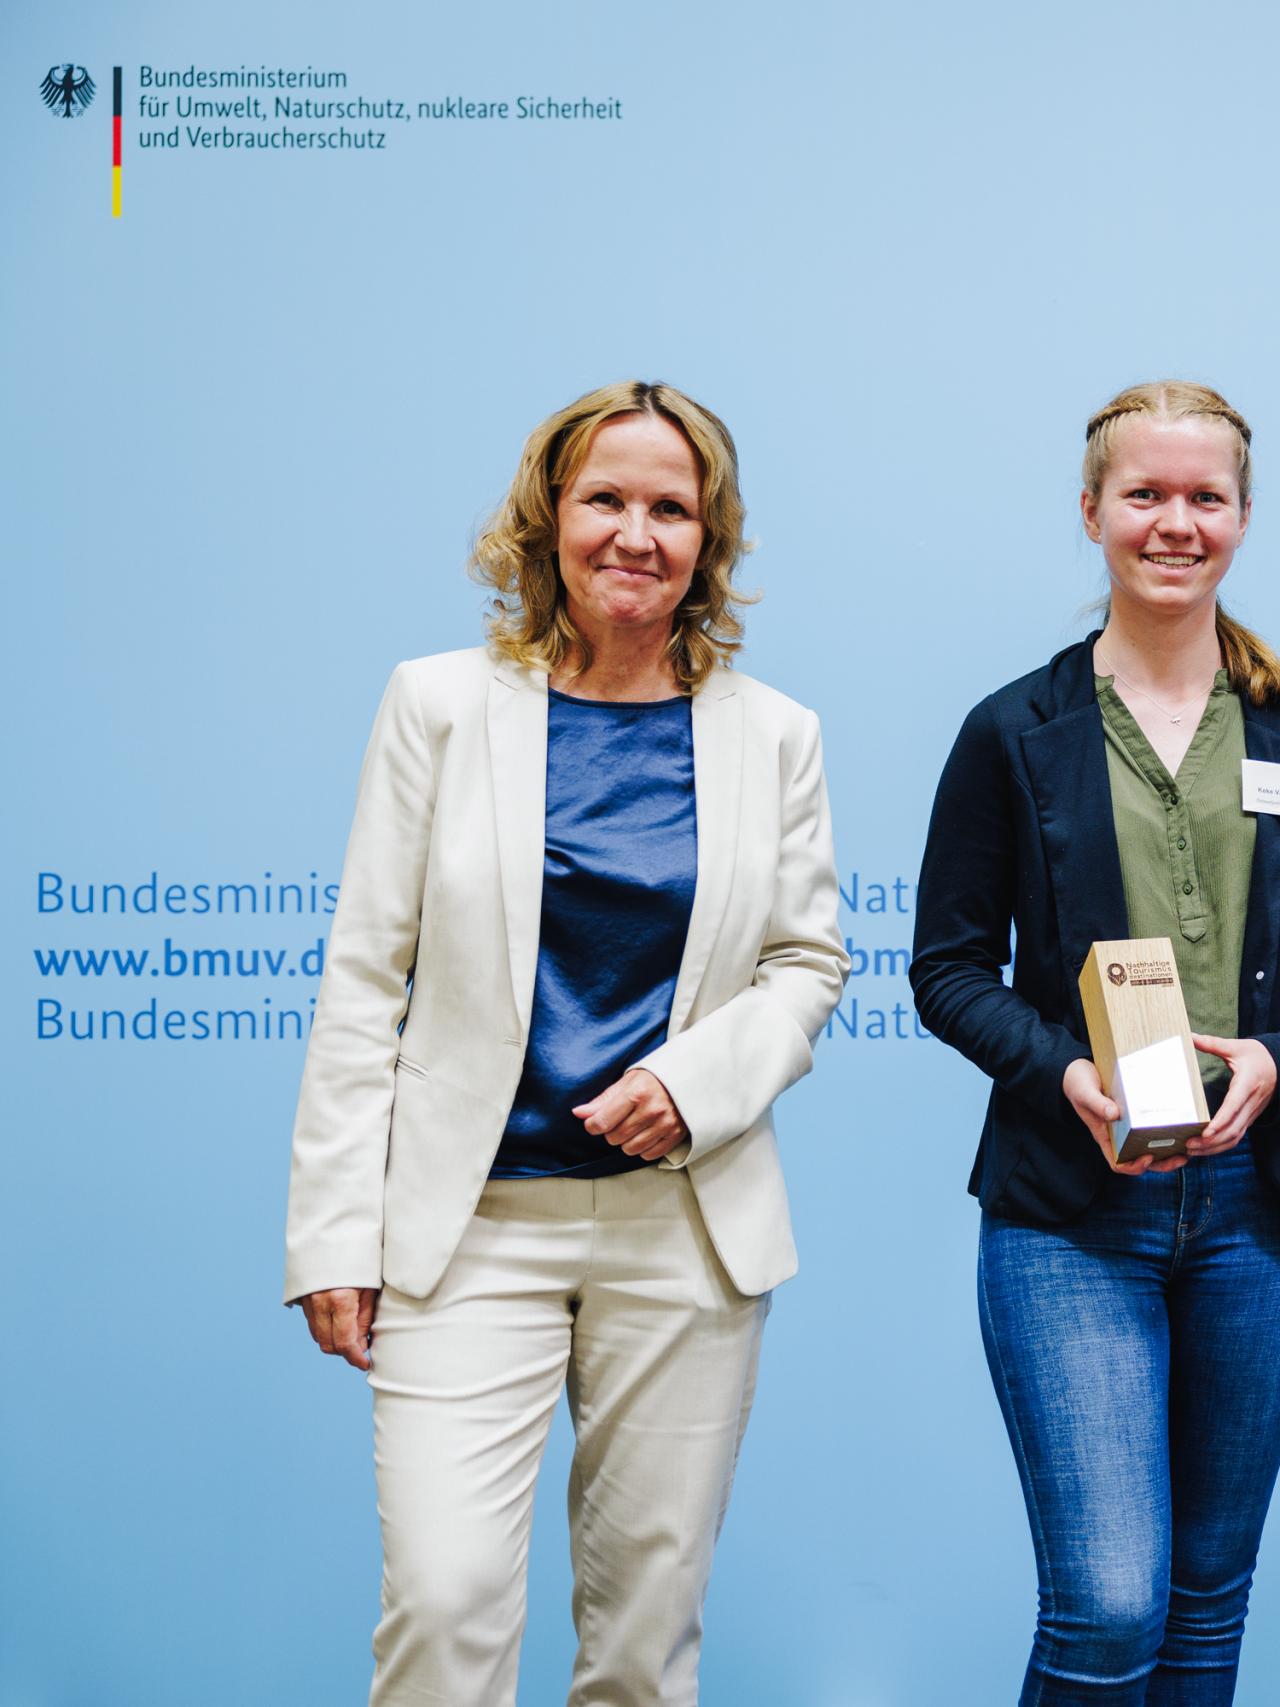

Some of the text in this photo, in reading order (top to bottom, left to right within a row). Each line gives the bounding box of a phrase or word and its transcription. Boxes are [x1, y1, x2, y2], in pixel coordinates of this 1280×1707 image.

[140, 66, 347, 89] Bundesministerium
[139, 96, 622, 121] für Umwelt, Naturschutz, nukleare Sicherheit
[139, 126, 386, 149] und Verbraucherschutz
